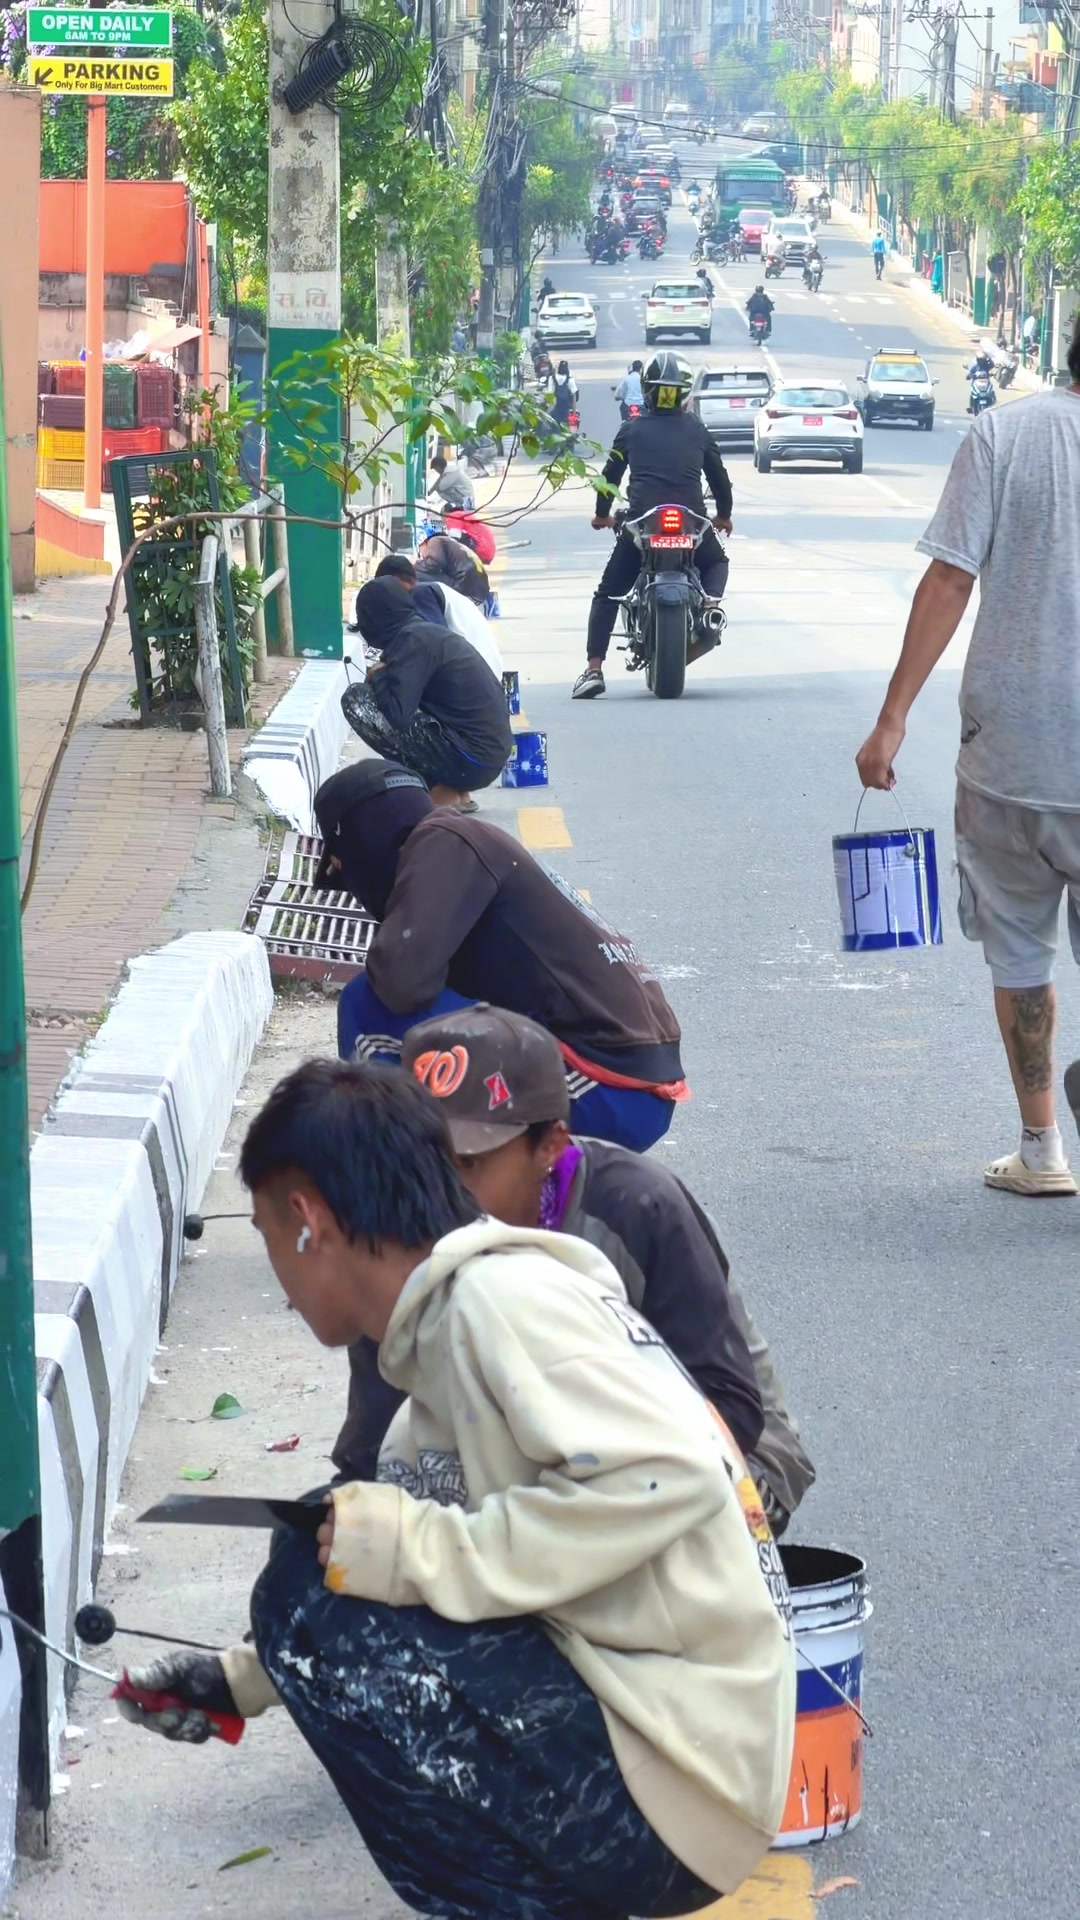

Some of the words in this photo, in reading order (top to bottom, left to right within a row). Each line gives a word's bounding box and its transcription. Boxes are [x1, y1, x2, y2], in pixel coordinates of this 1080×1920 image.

[41, 15, 94, 31] OPEN
[99, 16, 155, 32] DAILY
[65, 31, 88, 40] 6AM
[91, 32, 105, 41] TO
[108, 32, 131, 41] 9PM
[63, 62, 160, 81] PARKING
[55, 80, 73, 90] Only
[75, 81, 88, 89] For
[90, 81, 103, 91] Big
[104, 82, 123, 90] Mart
[125, 83, 168, 91] Customers
